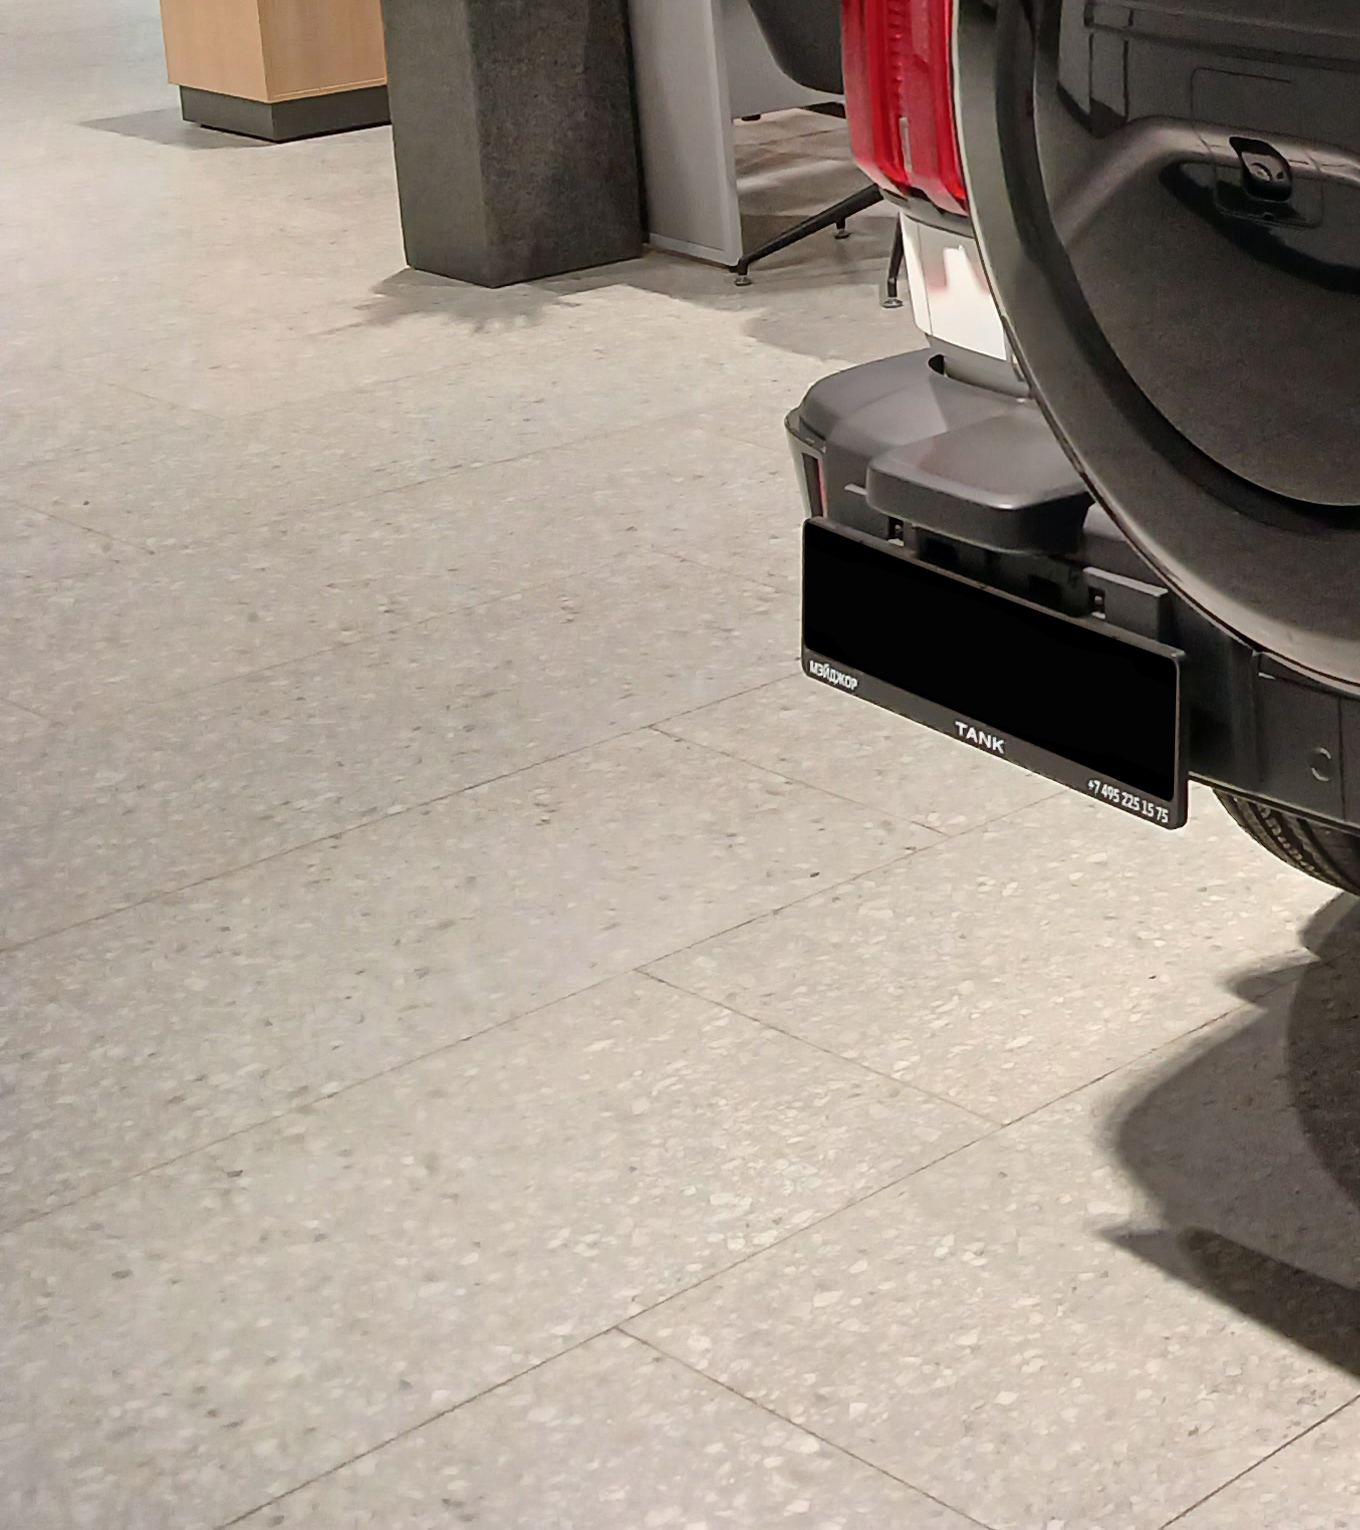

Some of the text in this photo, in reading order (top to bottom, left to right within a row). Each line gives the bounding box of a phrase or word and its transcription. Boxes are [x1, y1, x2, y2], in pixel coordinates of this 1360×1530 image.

[954, 720, 1006, 754] TANK
[1101, 783, 1120, 803] 495
[1121, 791, 1141, 811] 225
[1141, 799, 1155, 818] 15
[1155, 806, 1169, 823] 75
